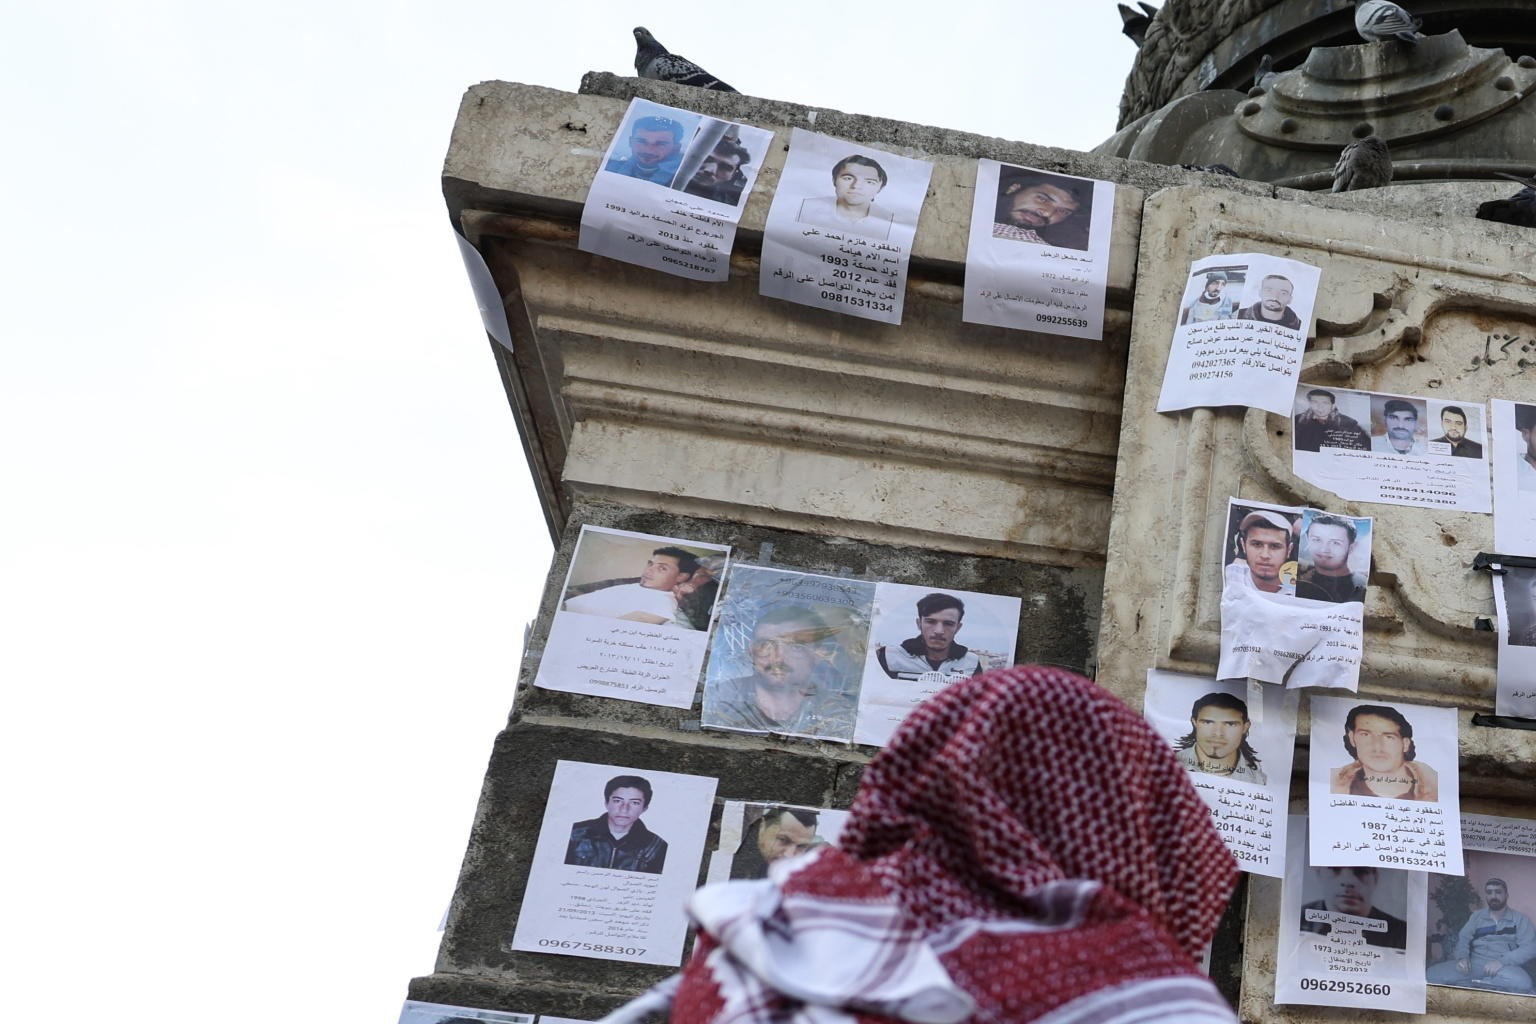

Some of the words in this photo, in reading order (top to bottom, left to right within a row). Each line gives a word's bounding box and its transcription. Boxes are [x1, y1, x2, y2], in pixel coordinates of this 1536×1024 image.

[871, 243, 901, 253] المفقود
[820, 254, 849, 267] 1993
[773, 268, 794, 279] الرقم
[832, 269, 862, 282] 2012
[880, 267, 898, 278] تولد
[818, 278, 853, 291] التواصل
[865, 276, 879, 285] عام
[883, 279, 897, 288] فقد
[856, 288, 876, 298] يجده
[879, 292, 896, 300] لمن
[821, 290, 894, 313] 0981531334
[1036, 313, 1088, 328] 0992255639
[1415, 807, 1442, 815] المفقود
[1216, 822, 1242, 834] 2014
[1361, 822, 1387, 831] 1987
[1372, 832, 1399, 843] 2013
[1429, 828, 1445, 837] تولد
[1332, 842, 1352, 851] الرقم
[1374, 843, 1407, 854] التواصل
[1410, 849, 1429, 857] يجده
[1431, 850, 1446, 858] لمن
[1379, 853, 1446, 868] 0991532411
[538, 937, 647, 956] 0967588307
[1314, 944, 1332, 953] 1973
[1300, 978, 1391, 996] 0962952660
